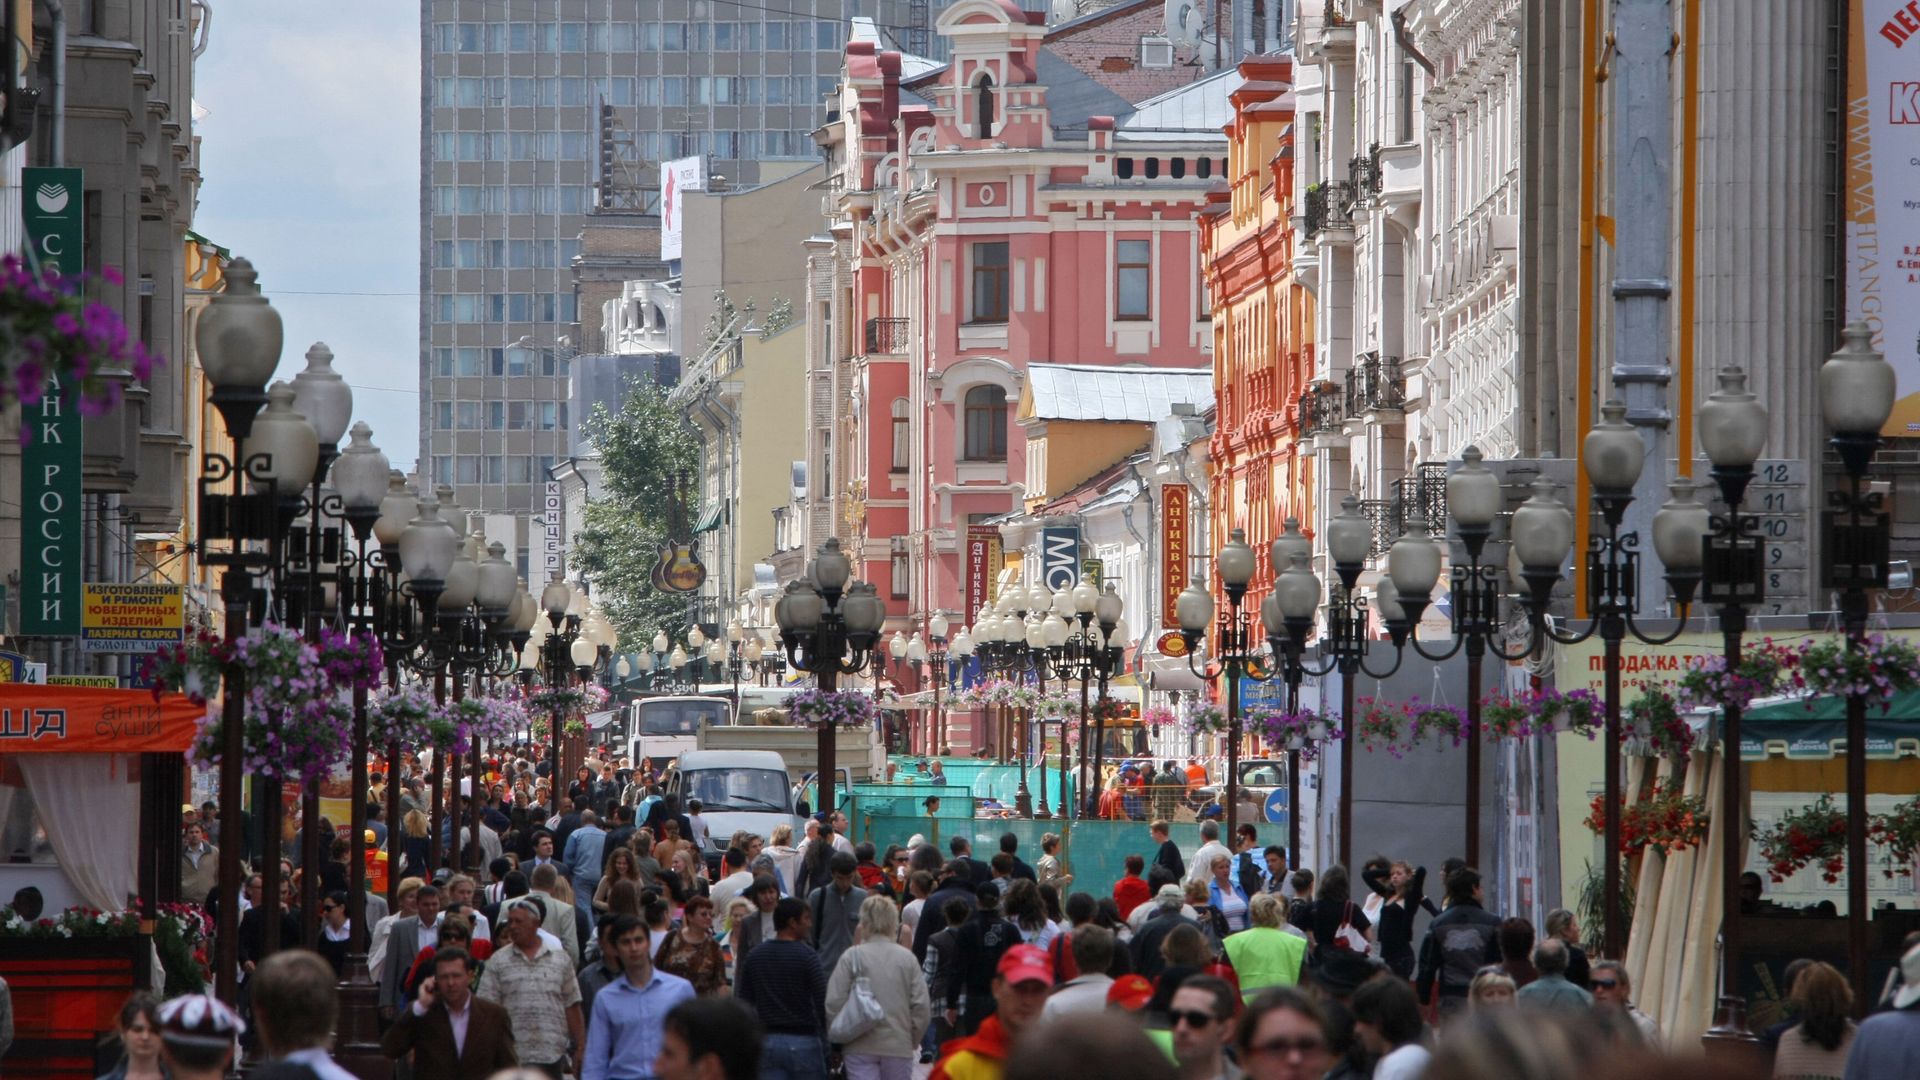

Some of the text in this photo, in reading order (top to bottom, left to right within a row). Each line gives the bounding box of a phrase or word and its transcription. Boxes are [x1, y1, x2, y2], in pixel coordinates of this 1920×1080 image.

[1763, 464, 1789, 483] 12
[1764, 493, 1785, 511] 11
[1764, 519, 1787, 537] 10
[40, 465, 63, 620] РОССИИ
[1771, 548, 1782, 564] 9
[1770, 573, 1780, 588] 8
[87, 585, 179, 595] ИЗГОТОВЛЕНИЕ
[102, 596, 164, 604] И РЕМОНТ
[88, 606, 177, 615] ЮВЕЛИРНЫХ
[1772, 604, 1781, 615] 7
[102, 616, 163, 626] ИЗДЕЛИЙ
[87, 629, 178, 639] ЛАЗЕРНАЯ СВАРКА
[87, 641, 138, 650] РЕМОНТ
[102, 704, 161, 720] анти
[95, 720, 161, 740] суши
